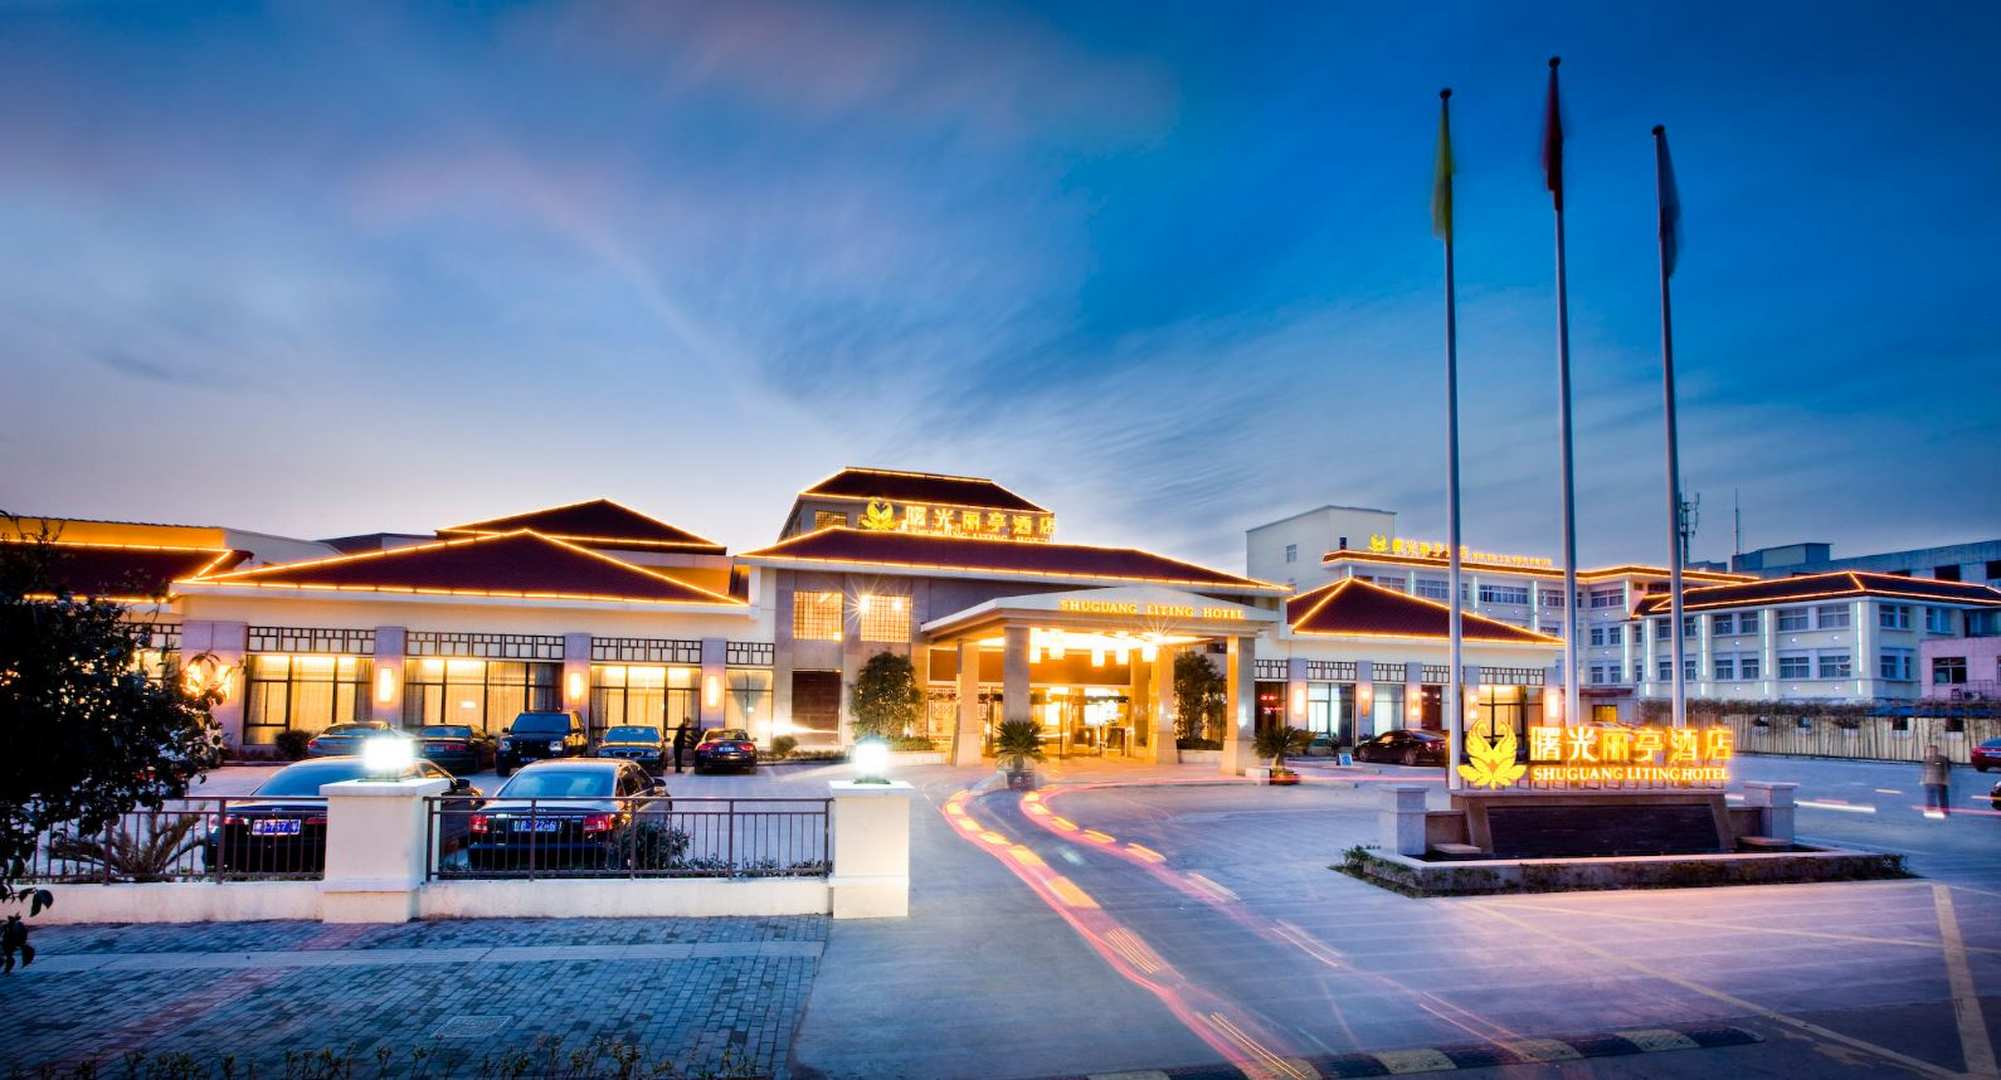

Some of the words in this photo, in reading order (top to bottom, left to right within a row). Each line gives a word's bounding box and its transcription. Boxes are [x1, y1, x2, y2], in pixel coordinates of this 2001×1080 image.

[1061, 600, 1137, 614] SHUGUANG
[1147, 604, 1194, 616] LITING
[1204, 608, 1245, 619] HOTEL
[1529, 726, 1734, 762] 曙光丽亭酒店
[1533, 767, 1623, 782] SHUGUANG
[1627, 767, 1680, 781] LITING
[1682, 767, 1730, 781] HOTEL
